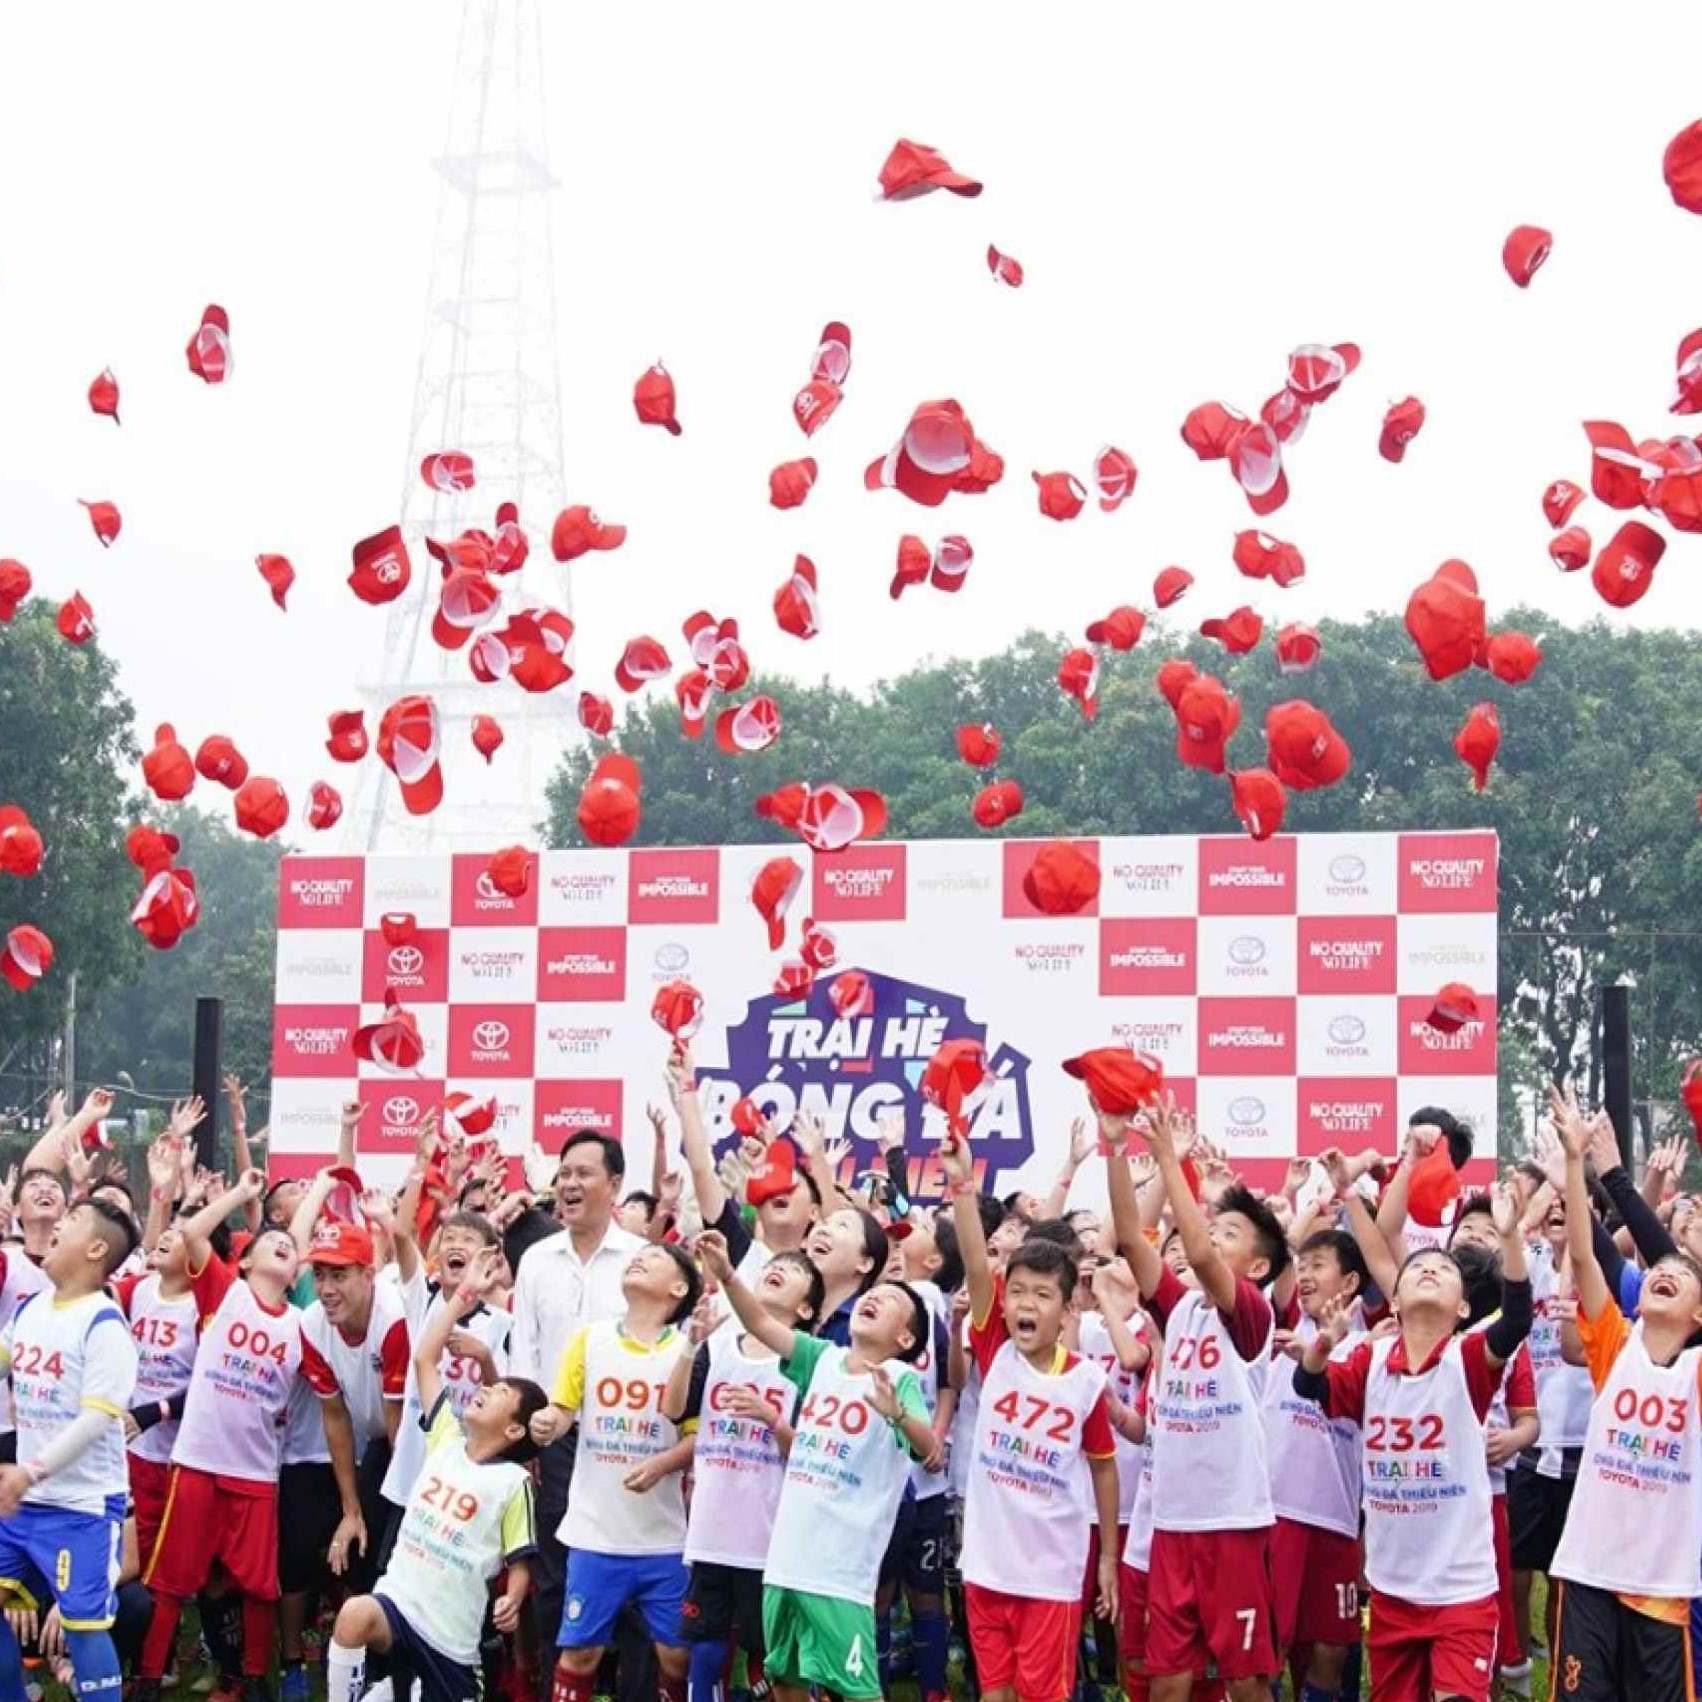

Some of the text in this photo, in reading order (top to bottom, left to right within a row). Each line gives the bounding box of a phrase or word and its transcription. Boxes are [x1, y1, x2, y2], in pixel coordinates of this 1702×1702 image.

[1410, 860, 1484, 875] NO QUALITY
[824, 869, 893, 884] NO QUALITY
[1210, 873, 1285, 886] IMPOSSIBLE
[291, 879, 353, 894] NO QUALITY
[639, 883, 709, 896] IMPOSSIBLE
[1326, 886, 1369, 896] TOYOTA
[475, 900, 514, 910] TOYOTA
[1310, 942, 1383, 956] NO QUALITY
[546, 960, 615, 974] IMPOSSIBLE
[1111, 953, 1186, 966] IMPOSSIBLE
[1226, 967, 1268, 977] TOYOTA
[385, 976, 425, 986] TOYOTA
[285, 1028, 348, 1042] NO QUALITY
[768, 1005, 949, 1072] TRẠI HÈ
[1209, 1033, 1284, 1046] IMPOSSIBLE
[471, 1050, 510, 1061] TOYOTA
[1326, 1046, 1368, 1056] TOYOTA
[699, 1063, 906, 1140] BÓNG
[1310, 1104, 1383, 1119] NO QUALITY
[544, 1113, 612, 1127] IMPOSSIBLE
[1226, 1127, 1268, 1137] TOYOTA
[132, 1316, 178, 1348] 413
[227, 1321, 287, 1365] 004
[13, 1342, 65, 1379] 224
[596, 1377, 667, 1412] 091
[801, 1392, 869, 1435] 420
[993, 1390, 1075, 1443] 472
[1615, 1388, 1687, 1433] 003
[1366, 1413, 1446, 1451] 232
[990, 1430, 1030, 1456] TRẠI
[1606, 1428, 1681, 1462] TRẠI HÈ
[1367, 1456, 1443, 1485] TRẠI HÈ
[1598, 1468, 1639, 1489] TOYOTA
[420, 1475, 479, 1522] 219
[1369, 1500, 1410, 1513] TOYOTA
[1235, 1607, 1257, 1651] 7
[845, 1633, 865, 1679] 4
